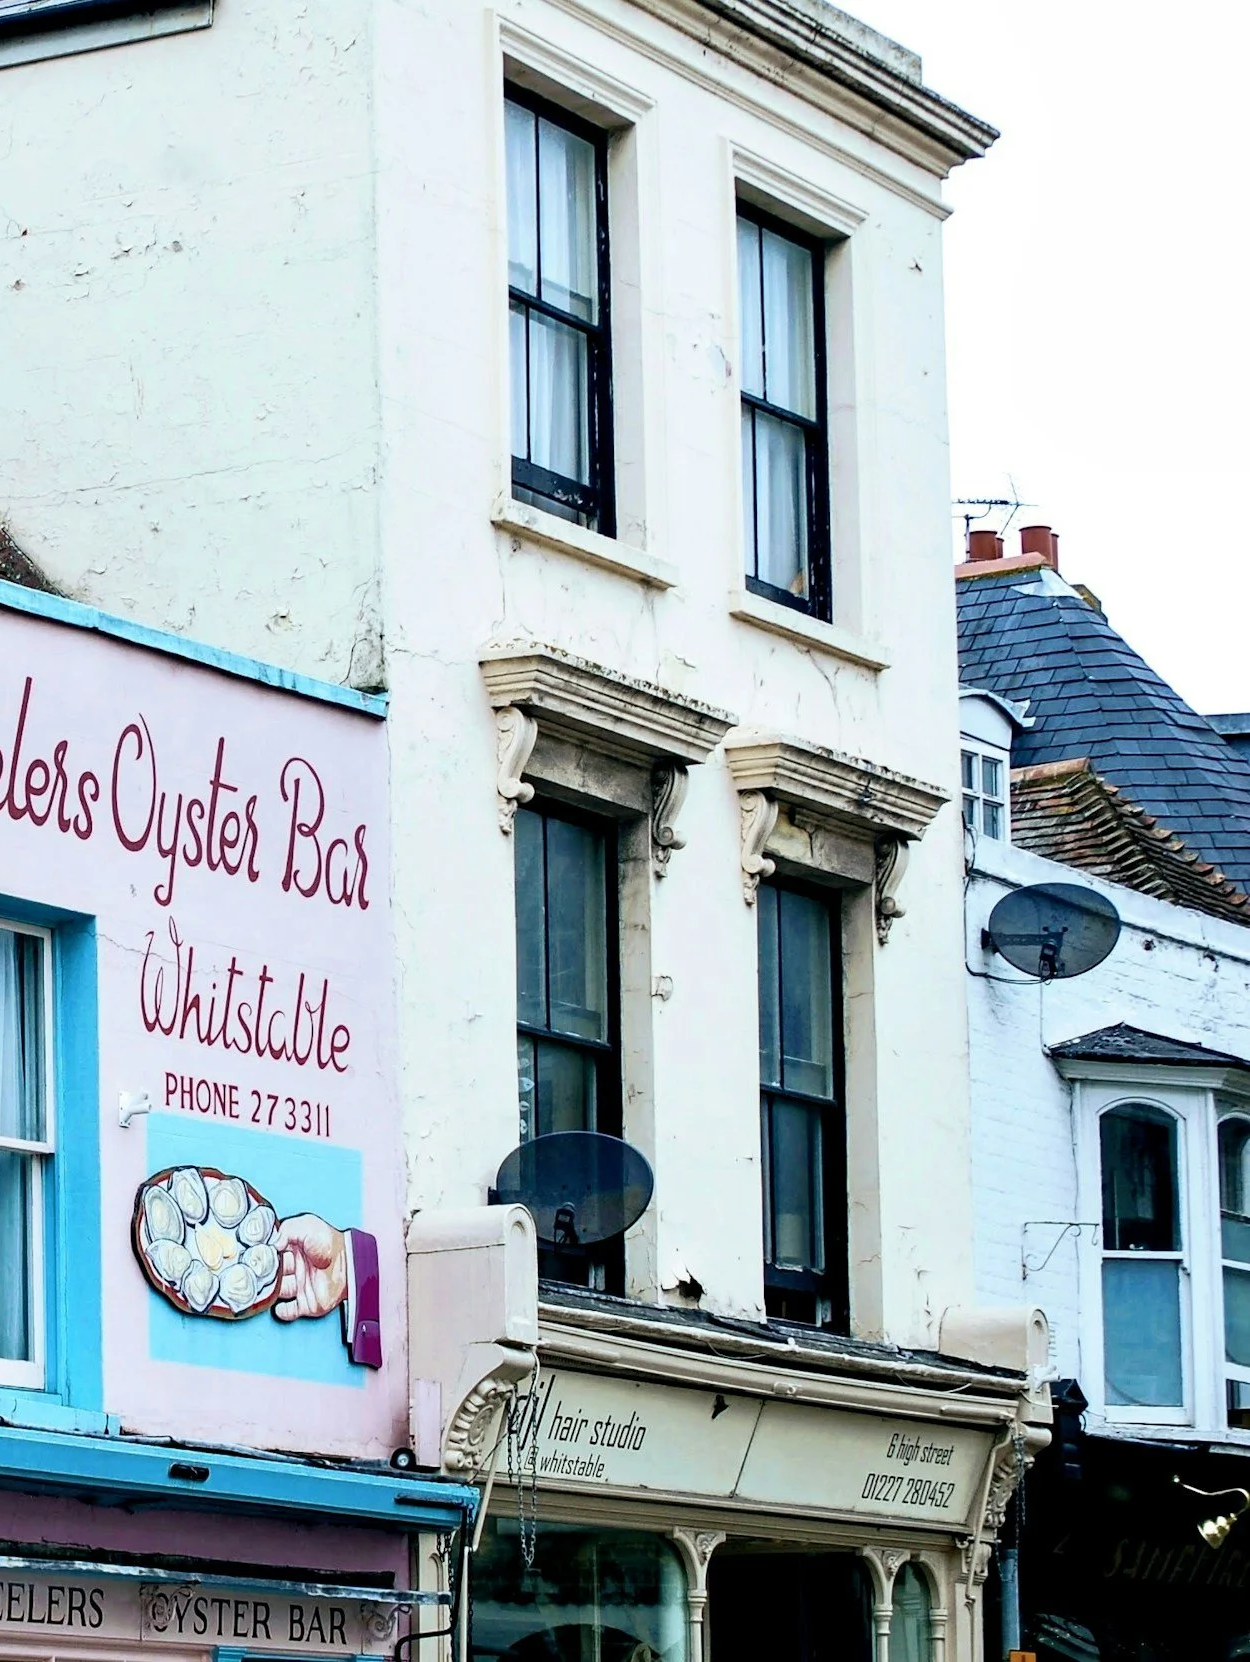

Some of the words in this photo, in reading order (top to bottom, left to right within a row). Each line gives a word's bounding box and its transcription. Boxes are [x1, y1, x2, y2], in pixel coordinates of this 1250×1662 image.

[112, 713, 260, 906] Oyster
[280, 757, 370, 910] Bar
[140, 915, 351, 1073] Whitstable
[165, 1072, 239, 1119] PHONE
[251, 1090, 330, 1137] 273311
[548, 1401, 589, 1444] hair
[590, 1411, 647, 1451] studio
[887, 1433, 899, 1458] 6
[898, 1434, 920, 1466] high
[920, 1443, 954, 1466] street
[540, 1450, 605, 1478] whitstable
[861, 1473, 903, 1501] 01227
[902, 1478, 955, 1508] 280452
[151, 1592, 272, 1640] OYSTER
[289, 1604, 347, 1645] BAR
